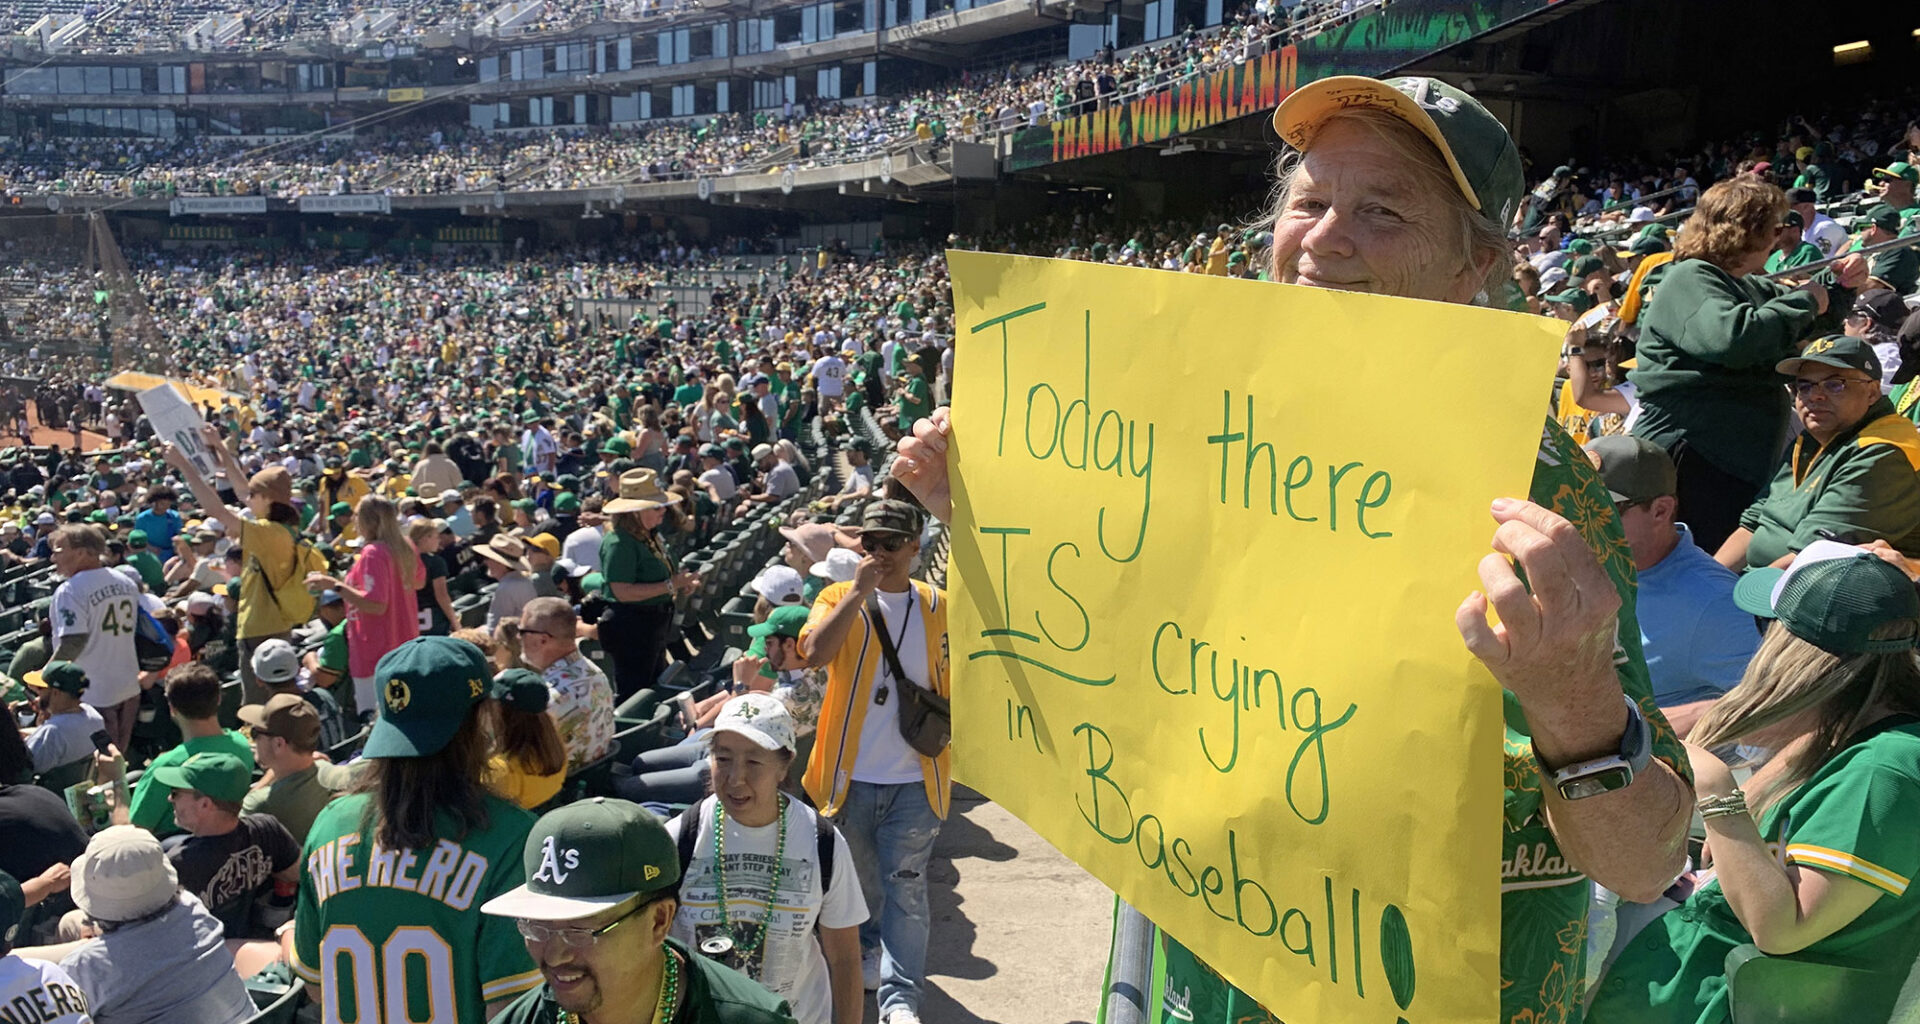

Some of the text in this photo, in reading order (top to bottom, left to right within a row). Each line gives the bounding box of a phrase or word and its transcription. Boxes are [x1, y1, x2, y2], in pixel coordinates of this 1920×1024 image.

[1051, 105, 1122, 162] THANK
[1131, 90, 1172, 145] YOU
[1178, 45, 1298, 134] OAKLAND
[826, 367, 839, 379] 43
[1802, 336, 1834, 356] A's
[972, 302, 1394, 562] Today there
[102, 600, 133, 637] 43
[980, 528, 1358, 826] IS crying
[732, 701, 760, 720] A's
[308, 832, 362, 906] THE
[366, 838, 488, 911] HERD
[532, 835, 580, 885] A's
[743, 863, 764, 873] STEP
[766, 864, 792, 878] AAY
[1006, 682, 1416, 1024] in Baseball!
[318, 924, 459, 1024] 00
